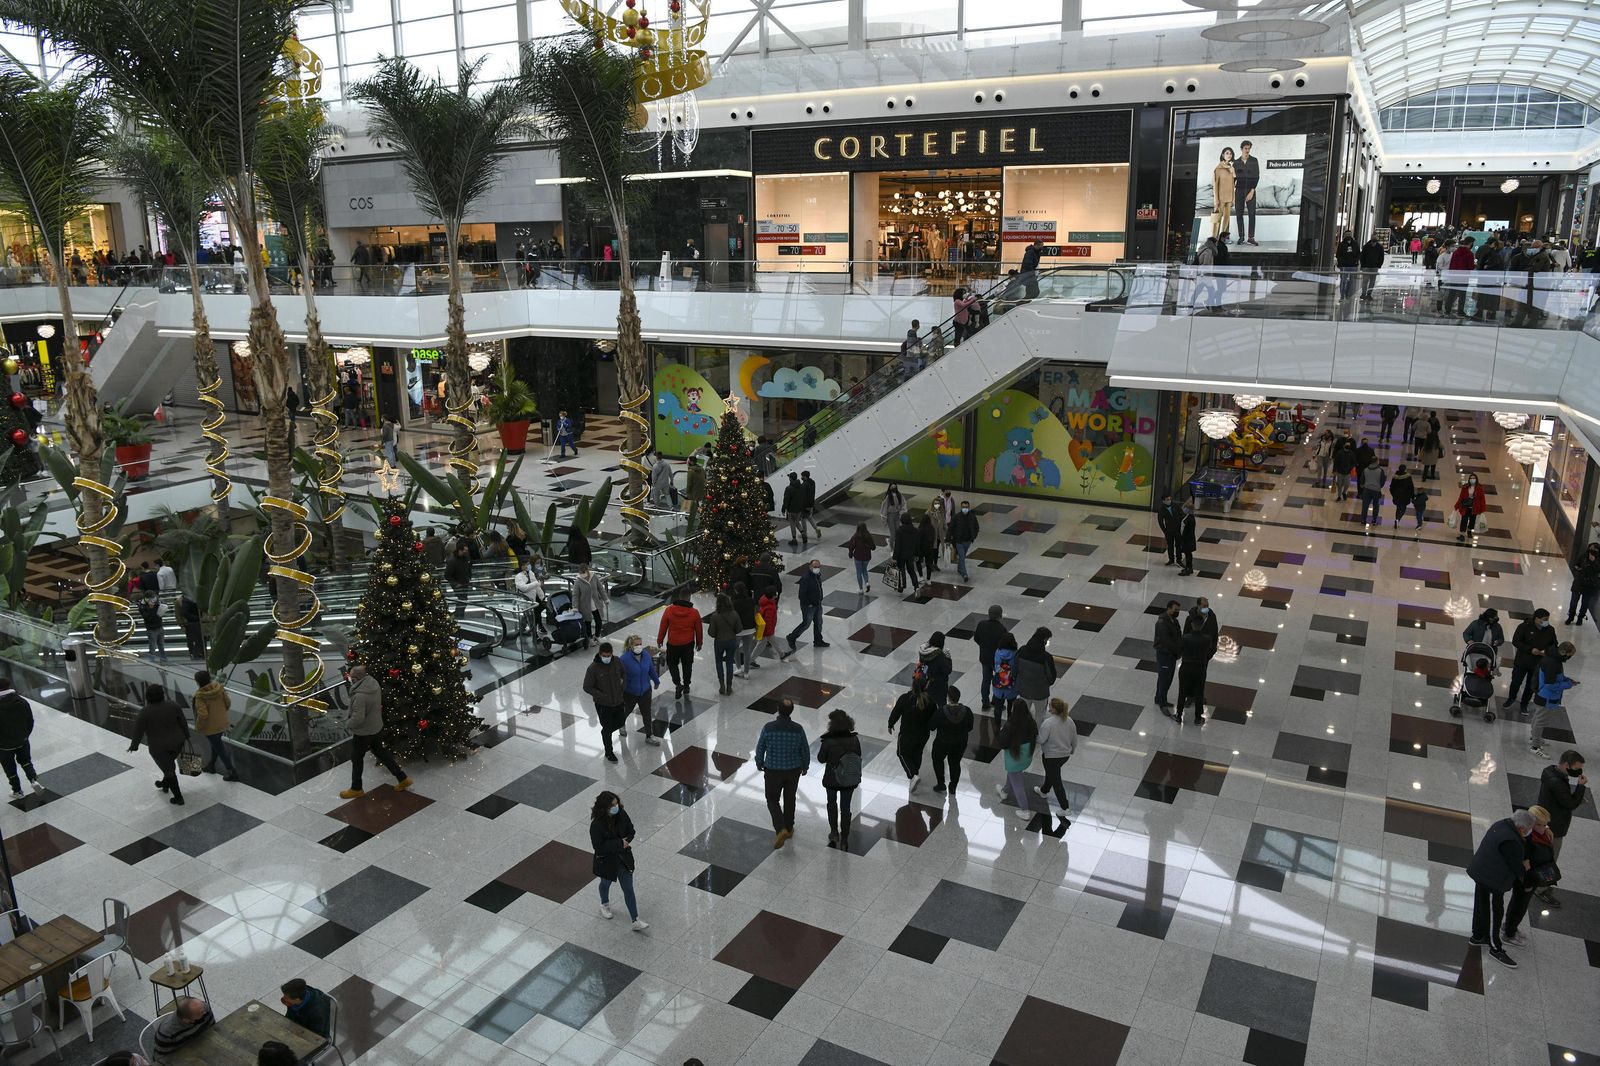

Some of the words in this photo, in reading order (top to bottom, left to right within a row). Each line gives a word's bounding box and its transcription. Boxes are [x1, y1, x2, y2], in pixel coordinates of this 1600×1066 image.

[814, 127, 1044, 160] CORTEFIEL
[349, 196, 374, 210] COS
[514, 228, 530, 236] COS
[1067, 387, 1153, 411] MAGIC
[1066, 410, 1156, 435] WORLD
